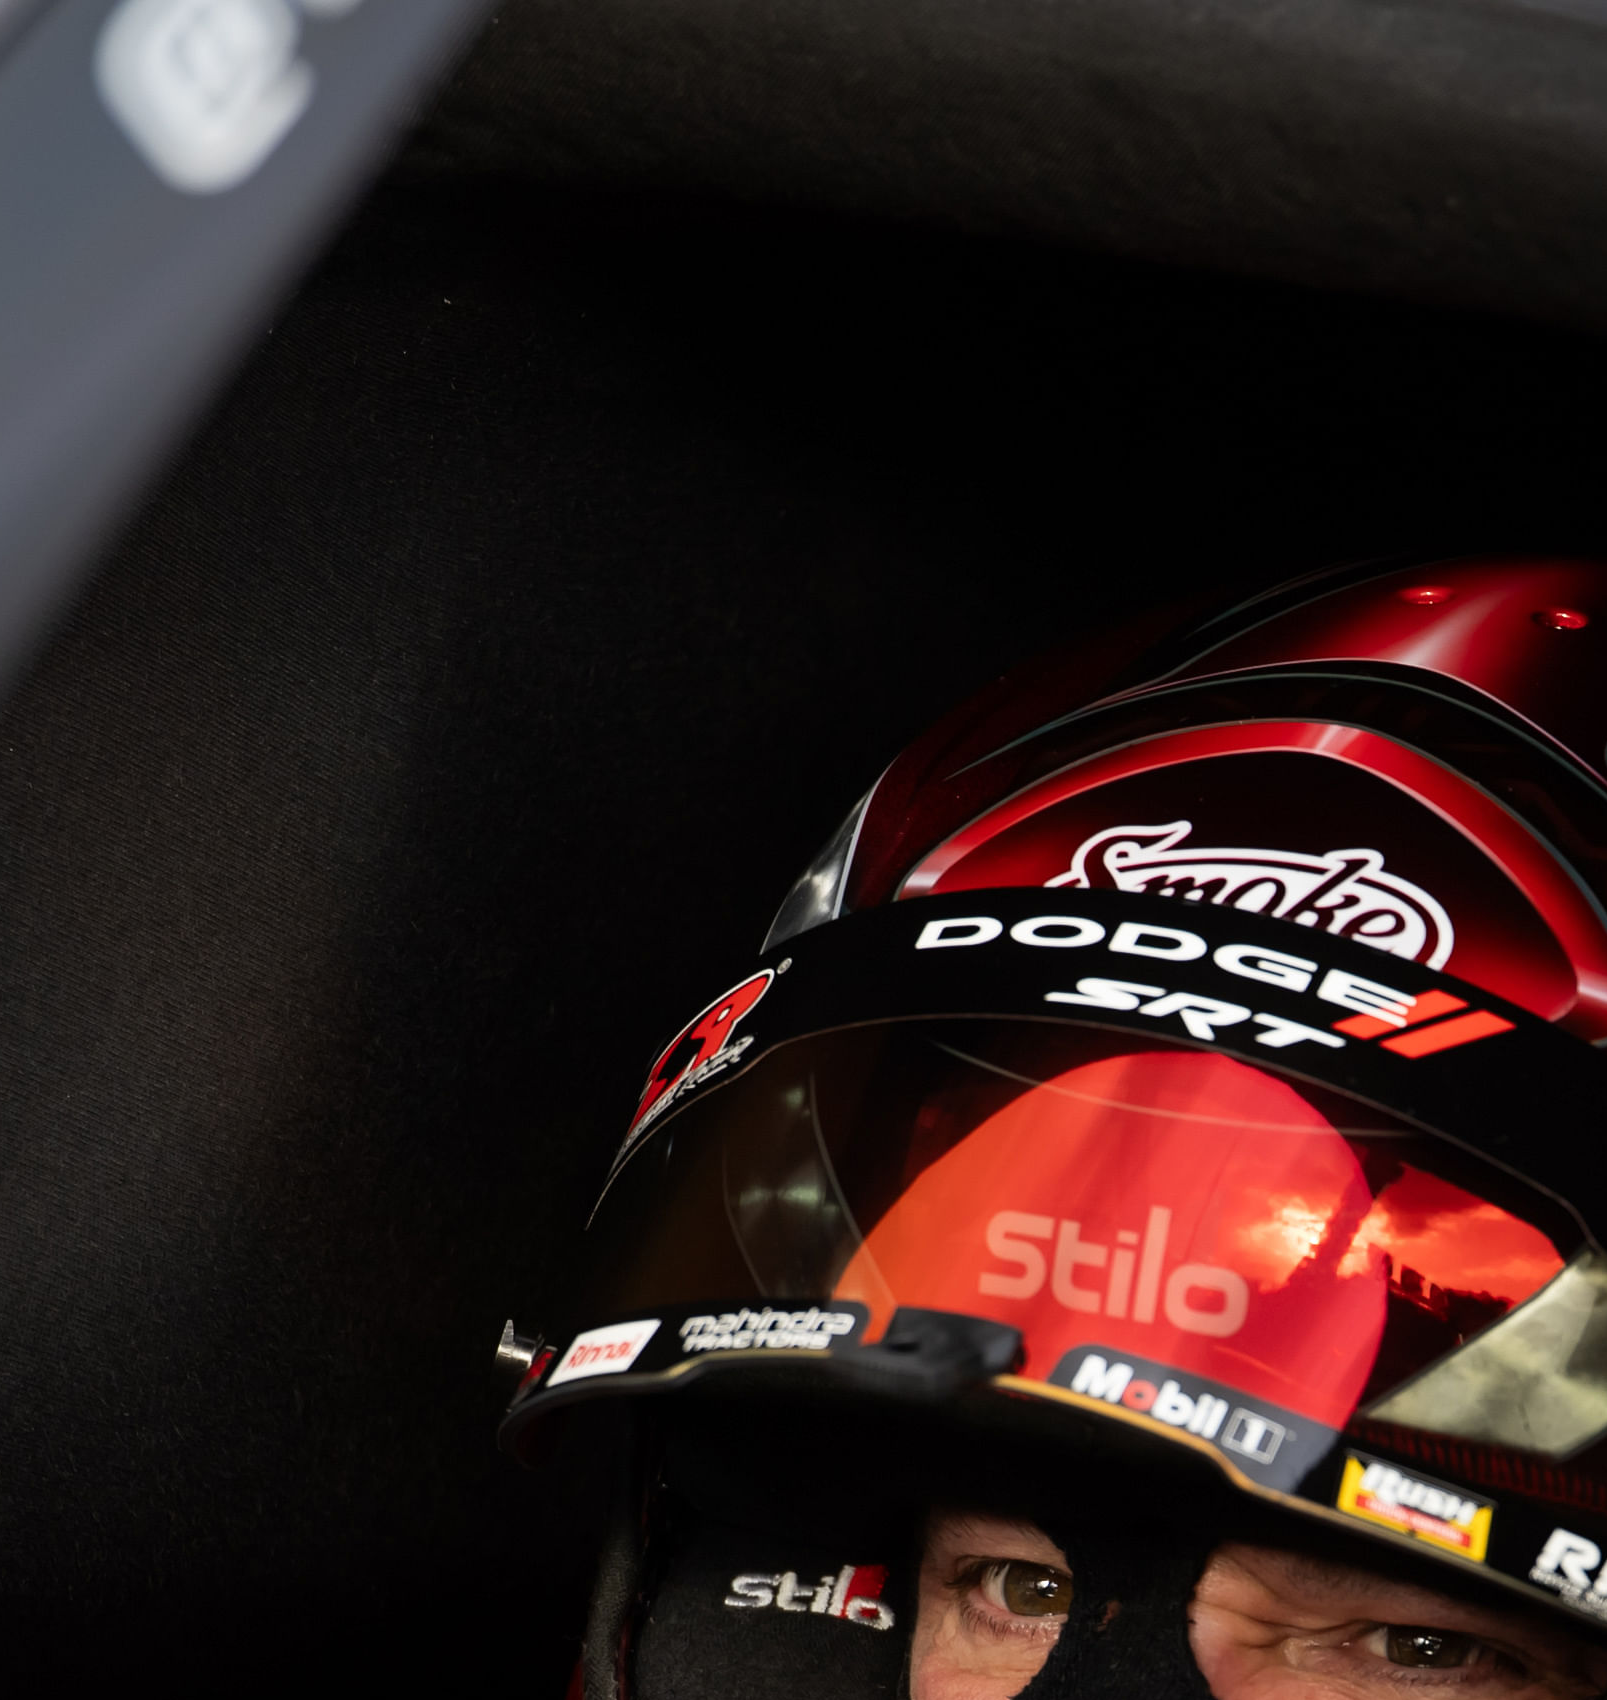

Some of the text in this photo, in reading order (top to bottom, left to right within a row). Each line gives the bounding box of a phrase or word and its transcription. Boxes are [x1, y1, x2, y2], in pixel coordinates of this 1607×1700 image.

[914, 915, 1418, 1028] DODGE
[1043, 977, 1347, 1048] SRT
[1070, 1353, 1230, 1440] Mobil
